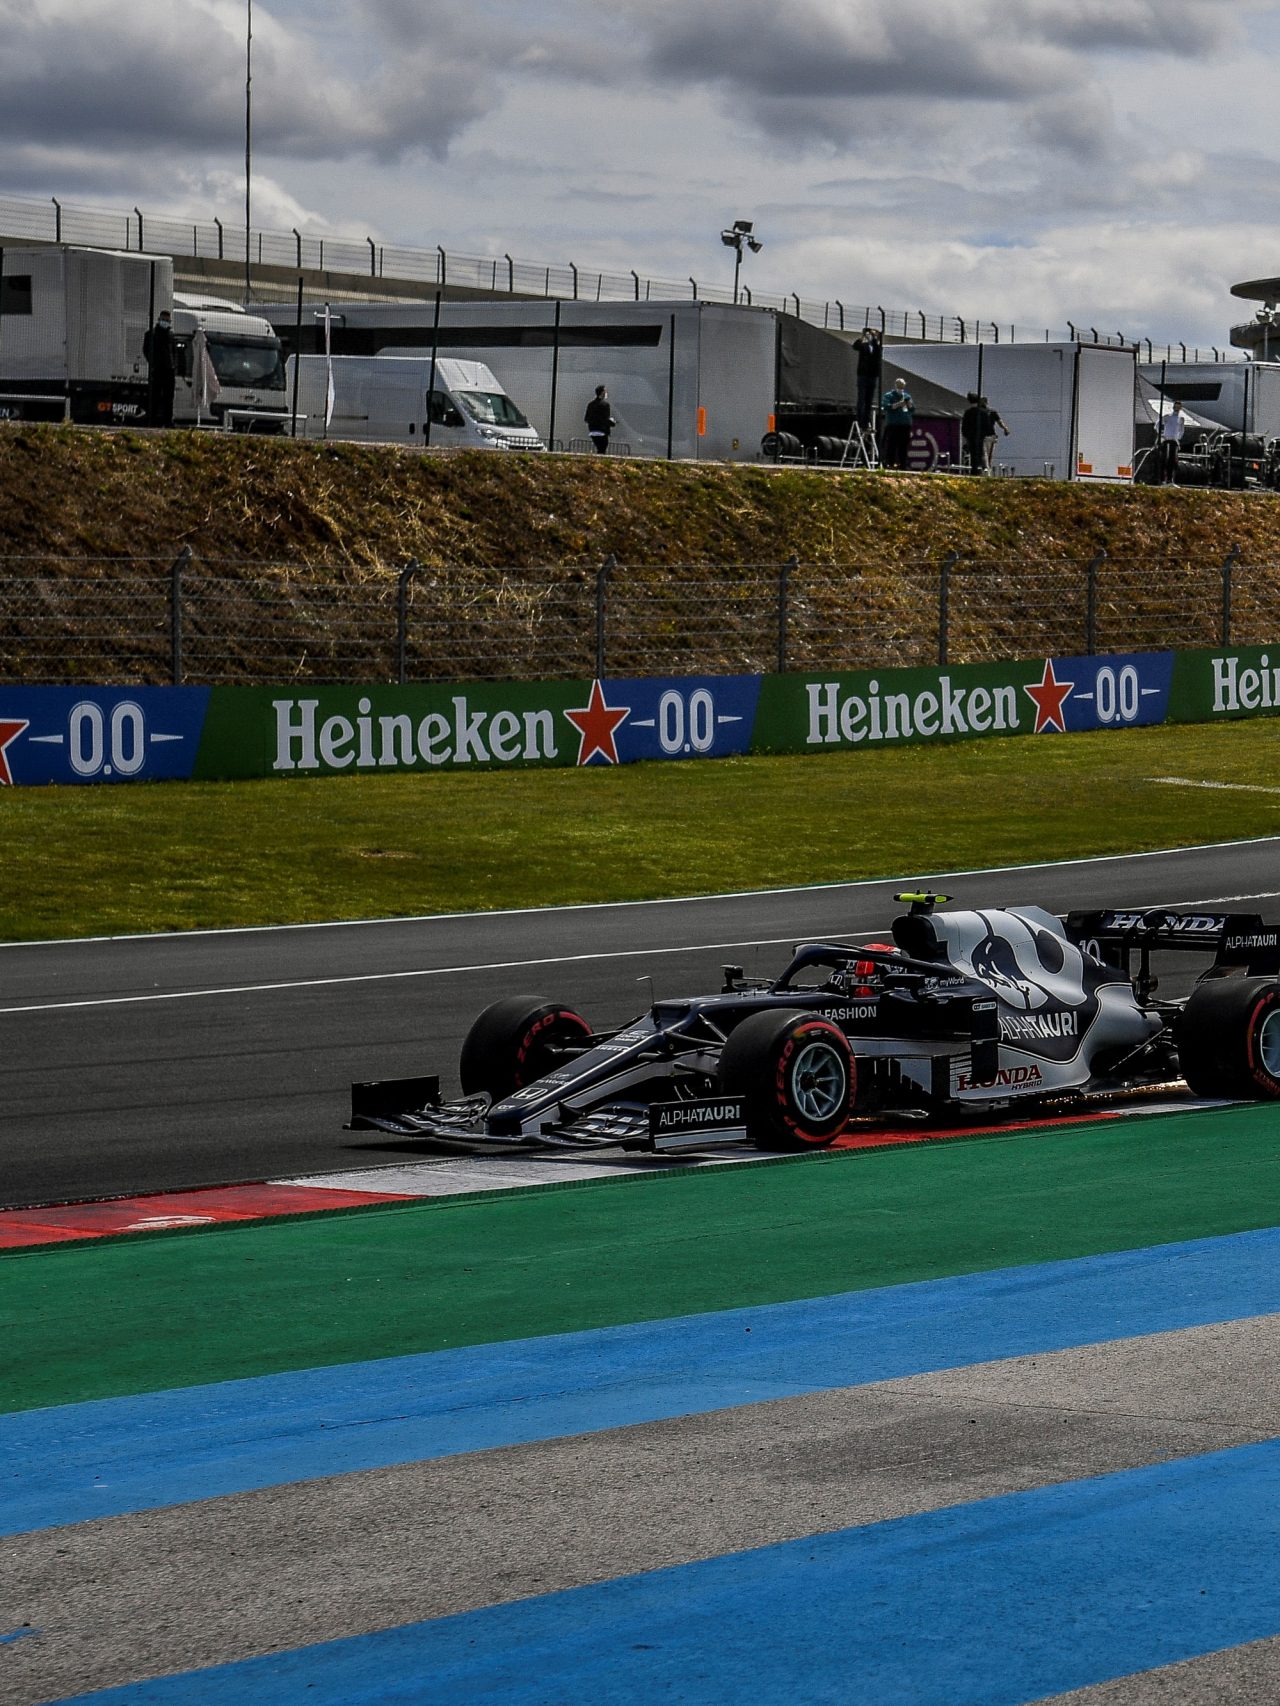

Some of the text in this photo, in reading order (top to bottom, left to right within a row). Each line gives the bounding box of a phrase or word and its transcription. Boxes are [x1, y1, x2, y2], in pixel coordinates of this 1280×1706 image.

[805, 665, 1139, 744] Heineken 0.0
[70, 702, 145, 775] 0.0
[272, 688, 714, 770] Heineken 0.0
[1225, 933, 1277, 950] ALPHATAURI
[939, 976, 965, 988] myWorld
[824, 1005, 877, 1020] FASHION
[999, 1010, 1078, 1041] ALPHATAURI
[1011, 1079, 1043, 1091] HYBRID
[659, 1104, 741, 1127] ALPHATAURI
